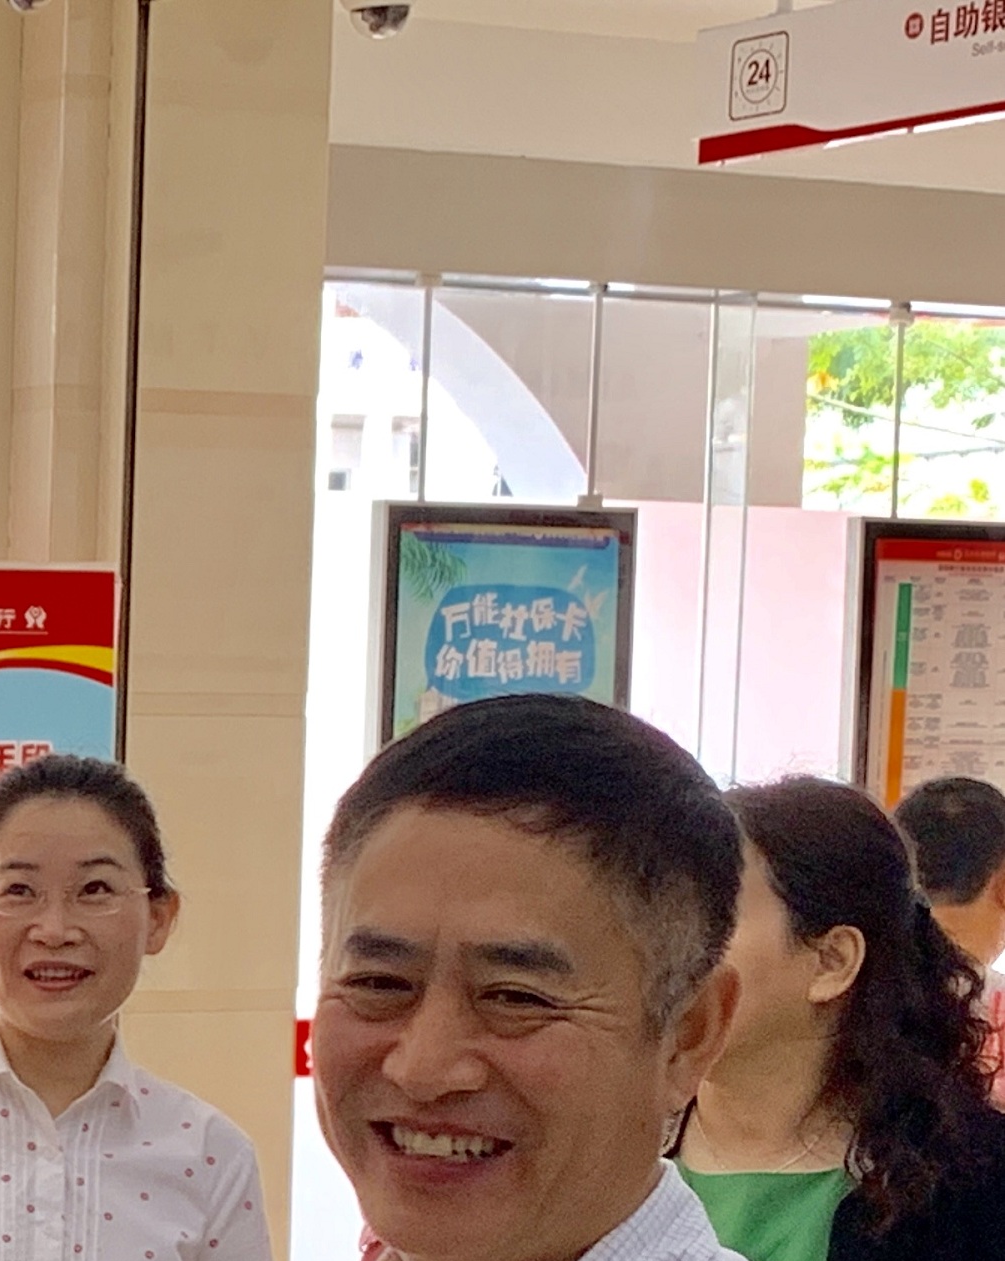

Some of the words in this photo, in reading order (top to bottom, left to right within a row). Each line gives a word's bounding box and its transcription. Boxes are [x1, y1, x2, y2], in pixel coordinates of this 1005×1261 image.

[930, 0, 1005, 45] 自助银
[747, 59, 771, 86] 24
[440, 592, 587, 641] 万能社保卡
[434, 638, 583, 685] 你值得拥有
